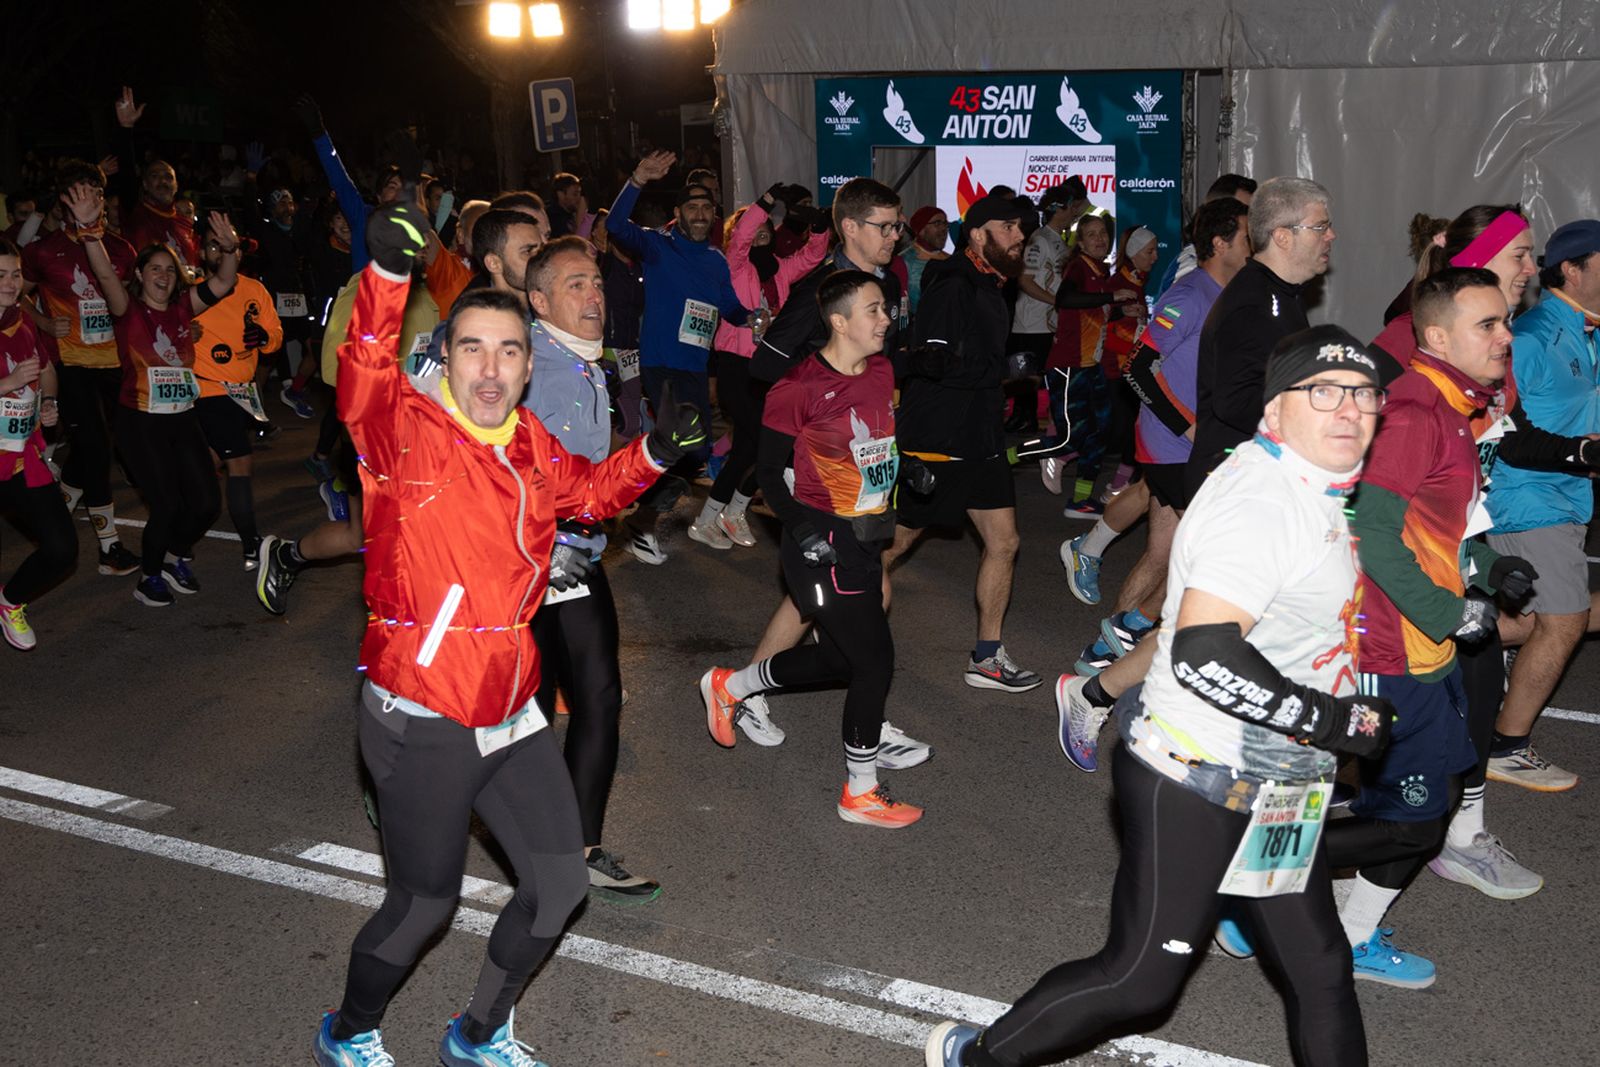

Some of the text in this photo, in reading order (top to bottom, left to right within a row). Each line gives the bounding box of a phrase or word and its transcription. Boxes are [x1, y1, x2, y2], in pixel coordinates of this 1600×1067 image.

[949, 85, 1037, 113] 43 SAN
[541, 88, 567, 143] P
[895, 116, 912, 134] 43
[941, 107, 1032, 139] ANTÓN
[1069, 114, 1087, 133] 43
[1028, 165, 1069, 173] NOCHE DE
[1119, 178, 1176, 188] calderón
[157, 383, 195, 400] 13754
[860, 456, 872, 467] SAN
[867, 460, 895, 487] 8815
[1174, 661, 1239, 706] SHUN
[1197, 660, 1275, 707] BAZAR
[1260, 812, 1276, 824] SAN
[1260, 824, 1304, 859] 7871
